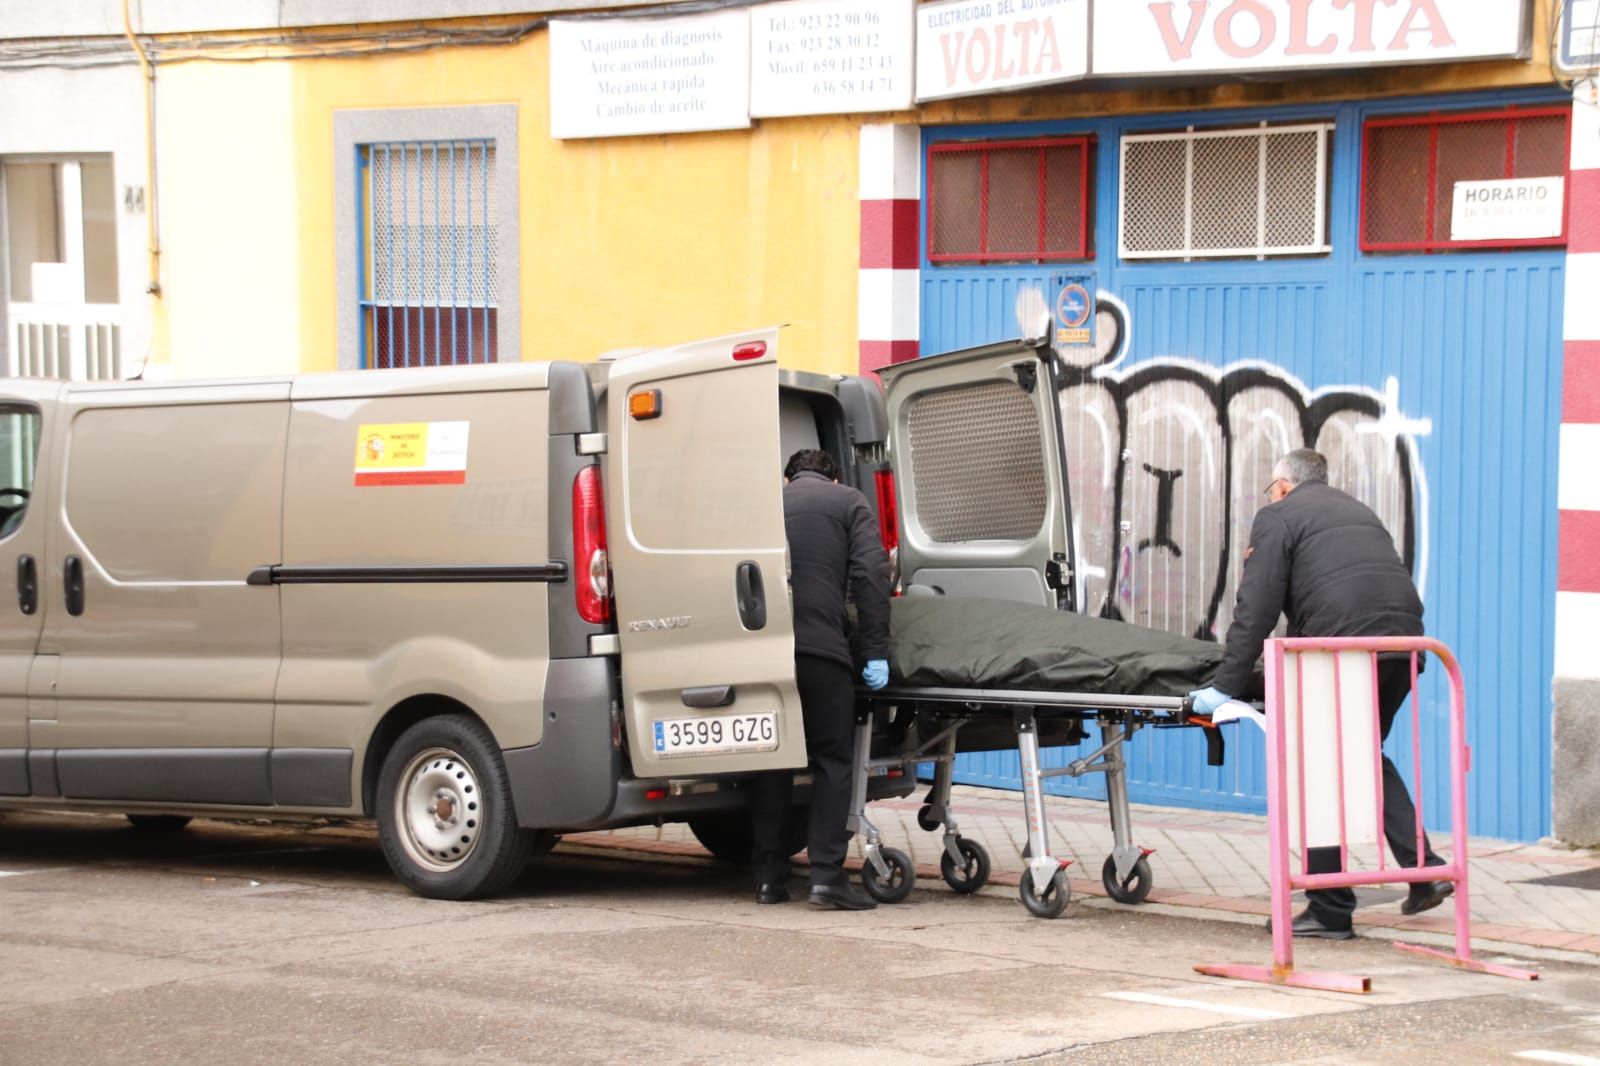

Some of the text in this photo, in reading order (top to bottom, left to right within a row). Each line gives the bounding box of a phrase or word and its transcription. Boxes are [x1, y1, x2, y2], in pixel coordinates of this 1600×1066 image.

[799, 15, 822, 30] 923
[827, 13, 841, 28] 22
[845, 12, 860, 26] 90
[864, 11, 880, 25] 96
[928, 6, 992, 28] ELECTRICIDAD
[997, 0, 1015, 15] DEL
[642, 32, 656, 48] de
[661, 26, 723, 47] diagnosis
[1148, 0, 1456, 62] VOLTA
[800, 37, 822, 52] 923
[827, 35, 842, 51] 28
[847, 34, 861, 48] 30
[866, 33, 880, 48] 12
[939, 16, 1062, 88] VOLTA
[590, 50, 715, 74] Aire acondicionado
[813, 58, 836, 72] 659
[841, 57, 852, 72] 11
[859, 56, 873, 71] 23
[879, 55, 893, 69] 43
[813, 77, 893, 95] 636 58 14 71
[596, 96, 706, 118] Cambio de aceite
[1464, 185, 1547, 203] HORARIO
[628, 616, 692, 633] RENAULT
[670, 717, 772, 747] 3599 GZG
